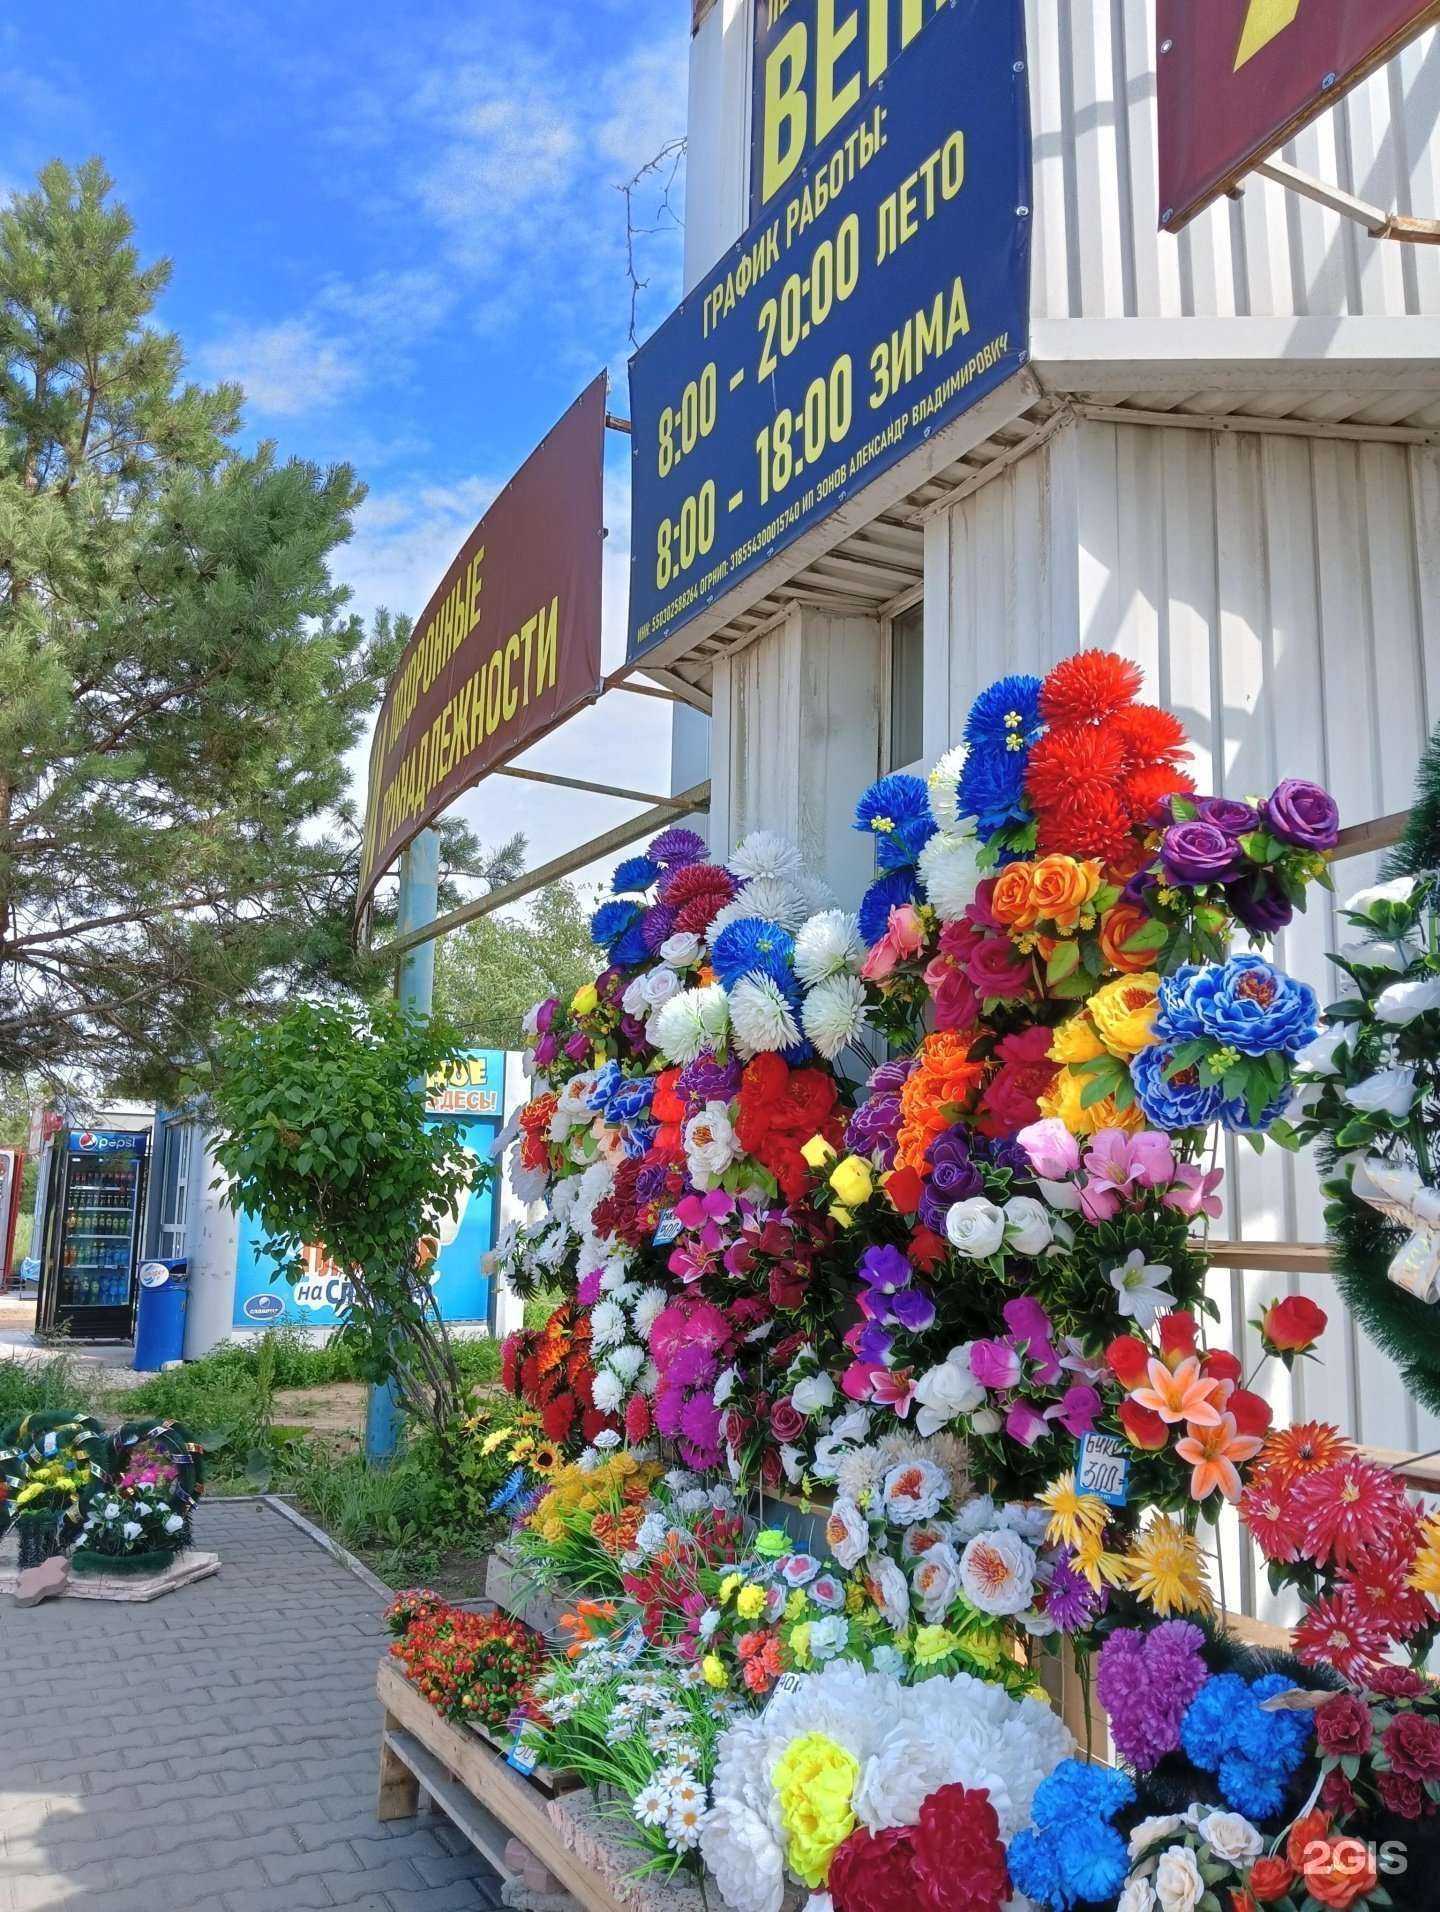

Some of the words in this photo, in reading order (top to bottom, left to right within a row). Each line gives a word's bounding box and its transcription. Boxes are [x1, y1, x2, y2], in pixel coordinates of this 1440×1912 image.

[658, 362, 716, 478] 8:00
[757, 212, 859, 384] 20:00
[877, 129, 965, 267] ЛЕТО
[703, 219, 780, 341] ГРАФИК
[786, 104, 888, 250] РАБОТЫ:
[656, 478, 716, 591] 8:00
[756, 353, 853, 506] 18:00
[869, 275, 971, 410] ЗИМА
[699, 561, 729, 595] ОГРНИП:
[730, 501, 800, 571] 318554300015740
[802, 488, 814, 515] ИП
[816, 463, 847, 503] ЗОНОВ
[849, 412, 909, 478] АЛЕКСАНДР
[912, 331, 1009, 427] ВЛАДИМИРОВИЧ
[378, 595, 560, 857] ПРИНАДЛЕЖНОСТИ
[388, 544, 487, 754] ПОХОРОННЫЕ
[98, 1136, 136, 1150] pepsi
[297, 1285, 322, 1302] на
